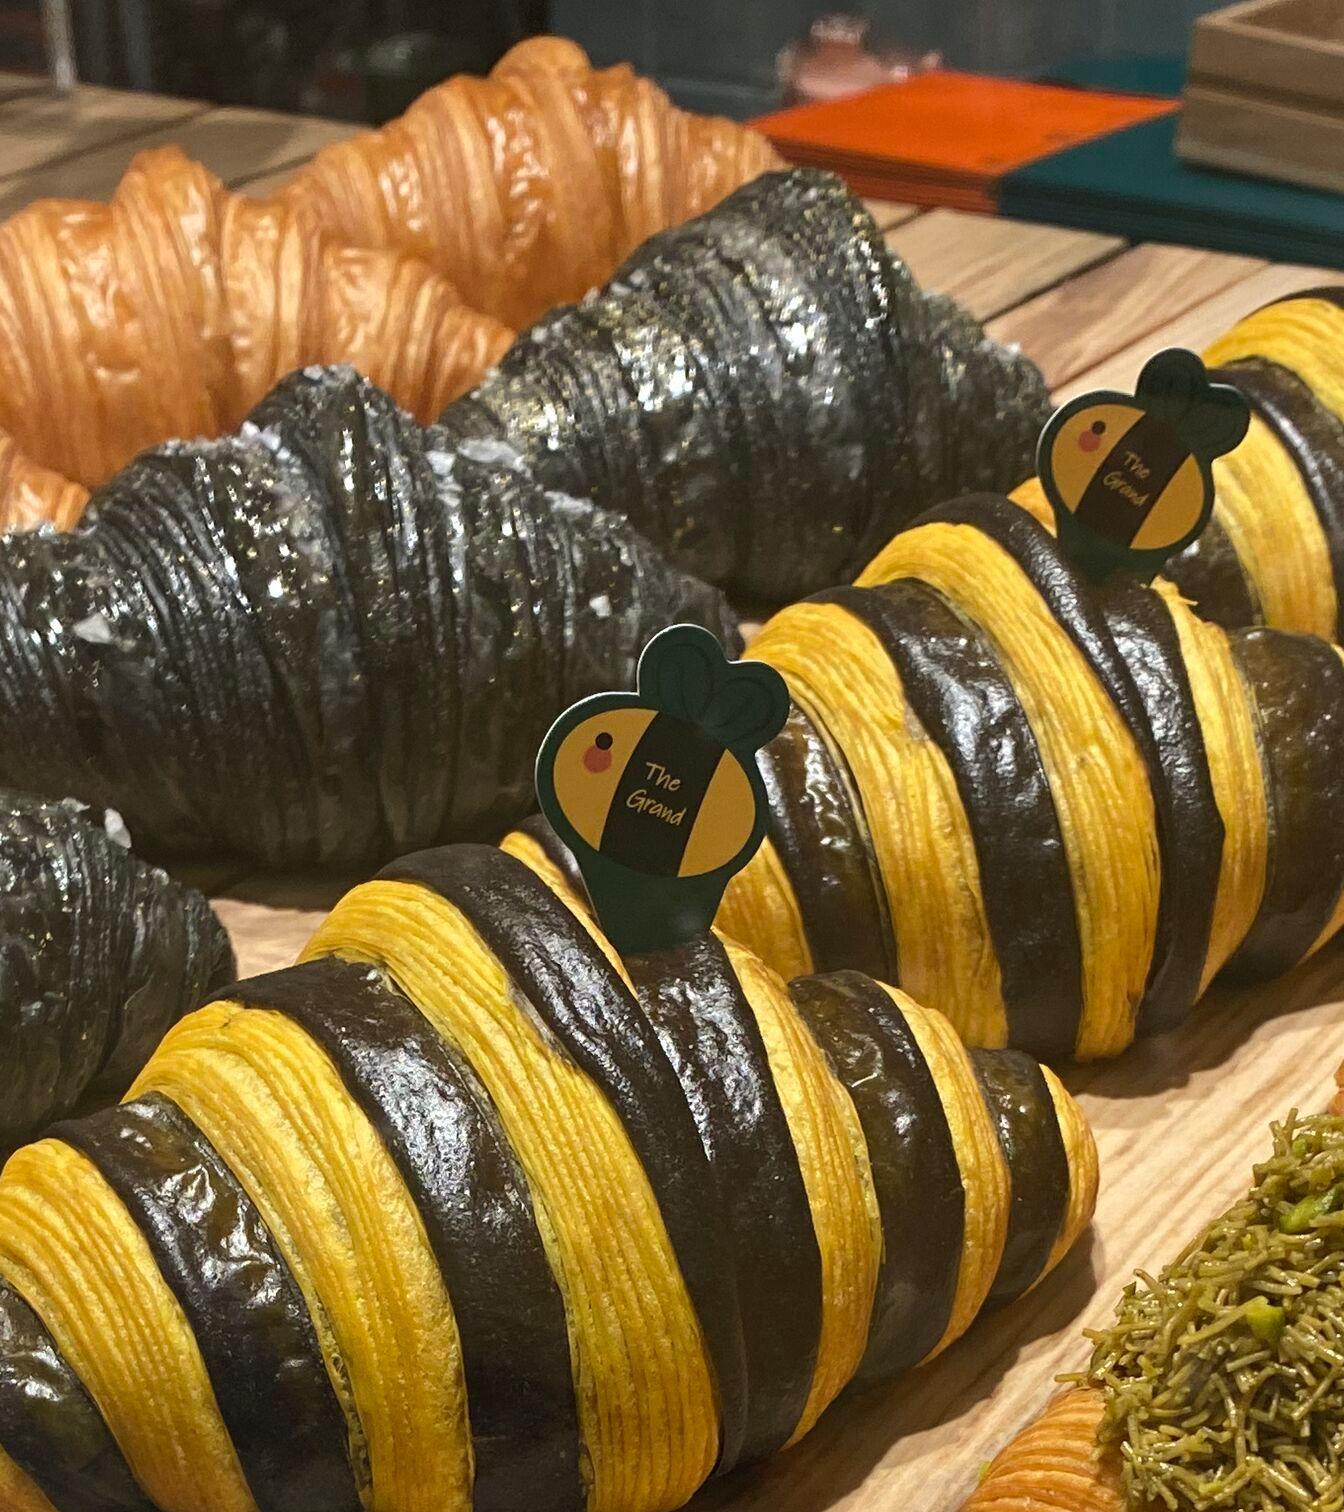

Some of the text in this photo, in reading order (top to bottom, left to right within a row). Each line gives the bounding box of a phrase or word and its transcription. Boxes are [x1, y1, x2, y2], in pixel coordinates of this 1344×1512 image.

[1124, 451, 1150, 479] The
[1103, 471, 1150, 507] Grand
[645, 761, 682, 791] The
[625, 789, 687, 827] Grand
